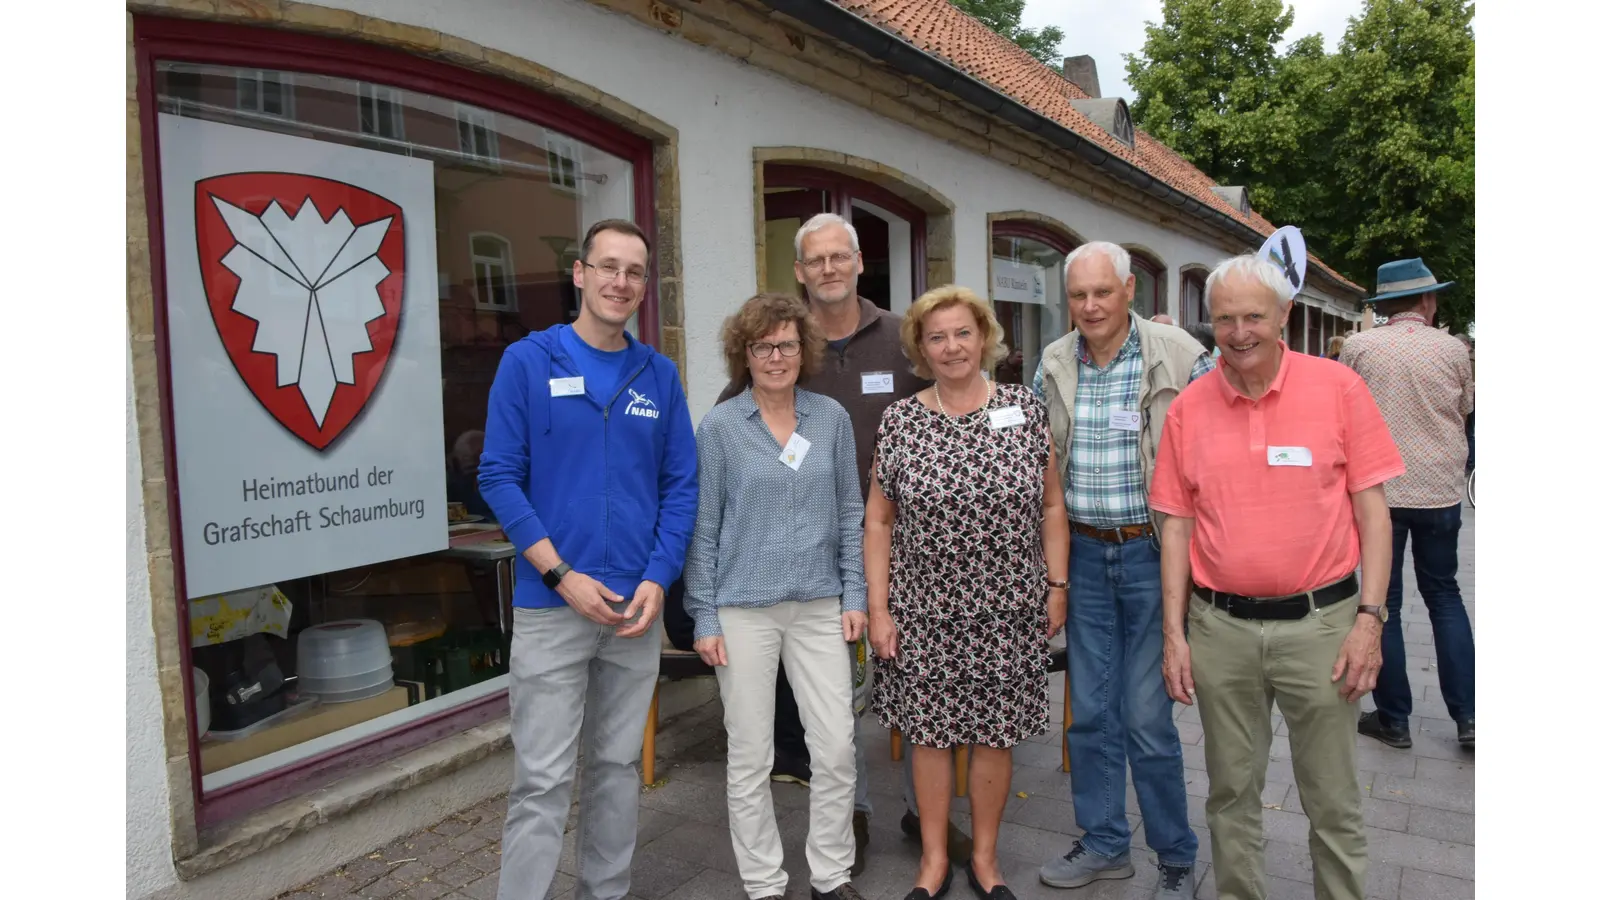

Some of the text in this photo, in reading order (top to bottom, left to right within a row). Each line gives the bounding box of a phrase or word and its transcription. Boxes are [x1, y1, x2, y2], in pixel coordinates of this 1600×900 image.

[631, 406, 660, 419] NABU
[242, 465, 394, 502] Heimatbund der
[203, 498, 425, 546] Grafschaft Schaumburg
